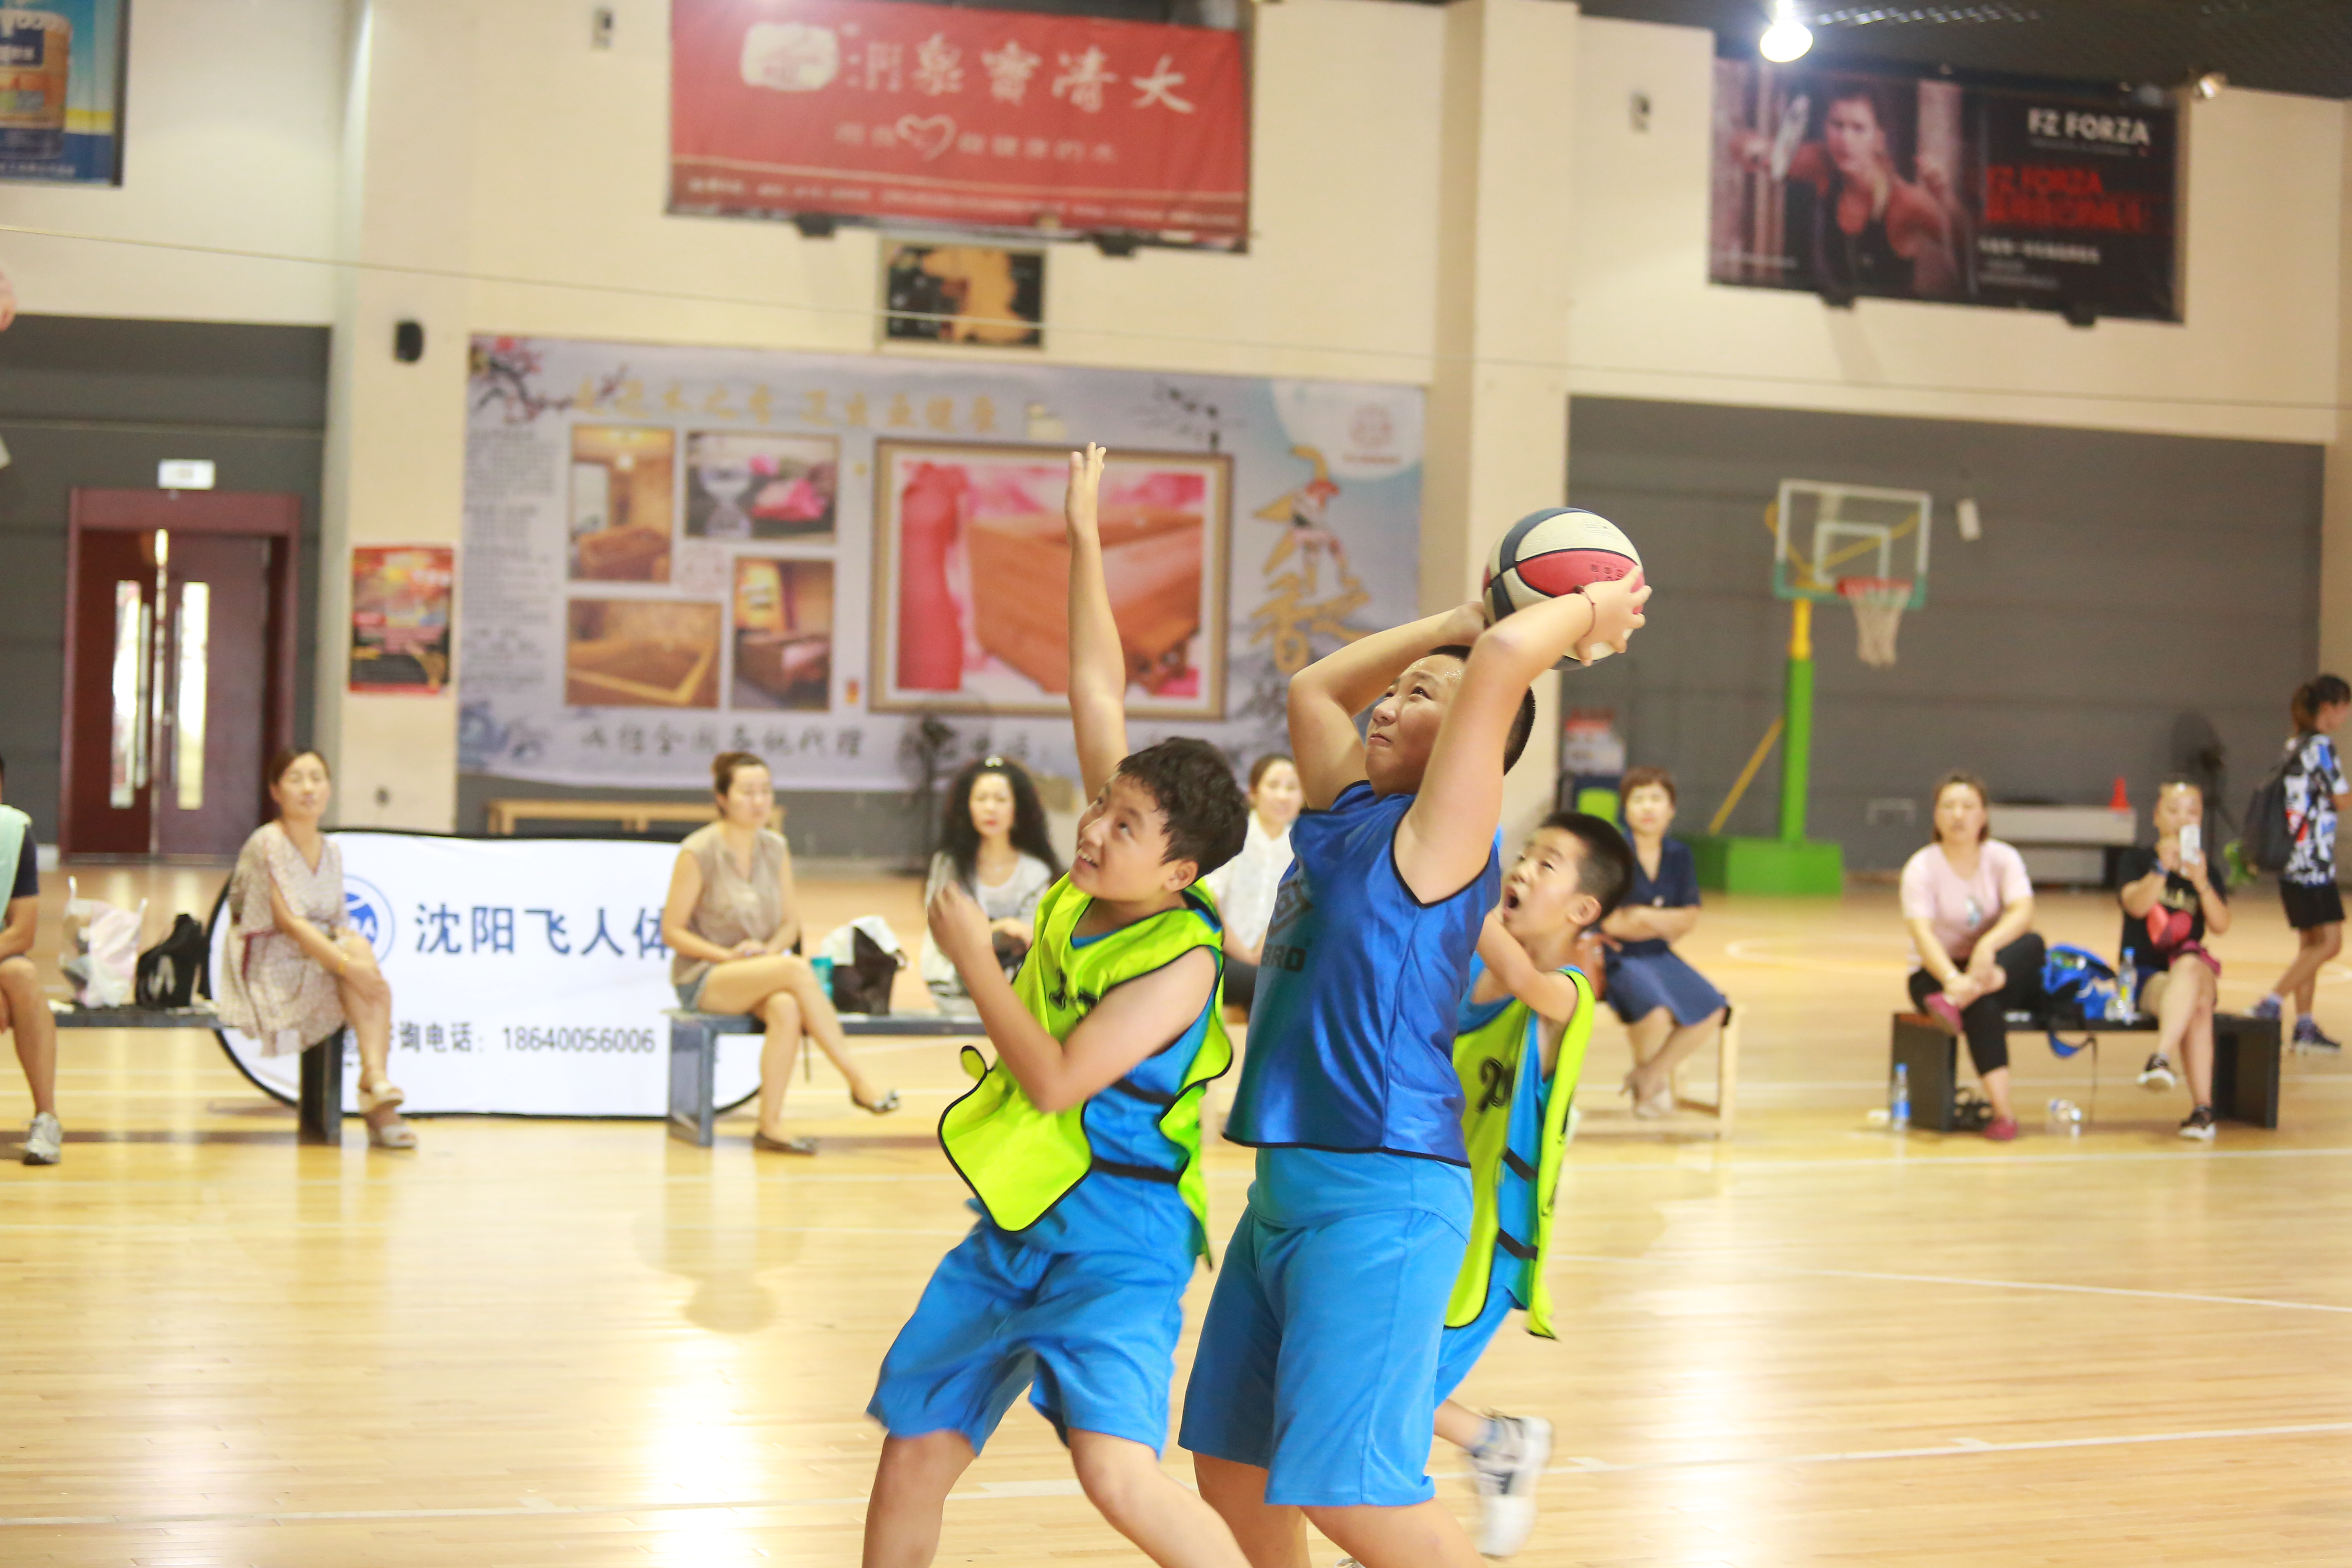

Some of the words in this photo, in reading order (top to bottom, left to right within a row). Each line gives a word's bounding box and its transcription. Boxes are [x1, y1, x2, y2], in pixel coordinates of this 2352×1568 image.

[2027, 108, 2060, 137] FZ
[2065, 110, 2150, 146] FORZA
[502, 1026, 656, 1053] 18640056006
